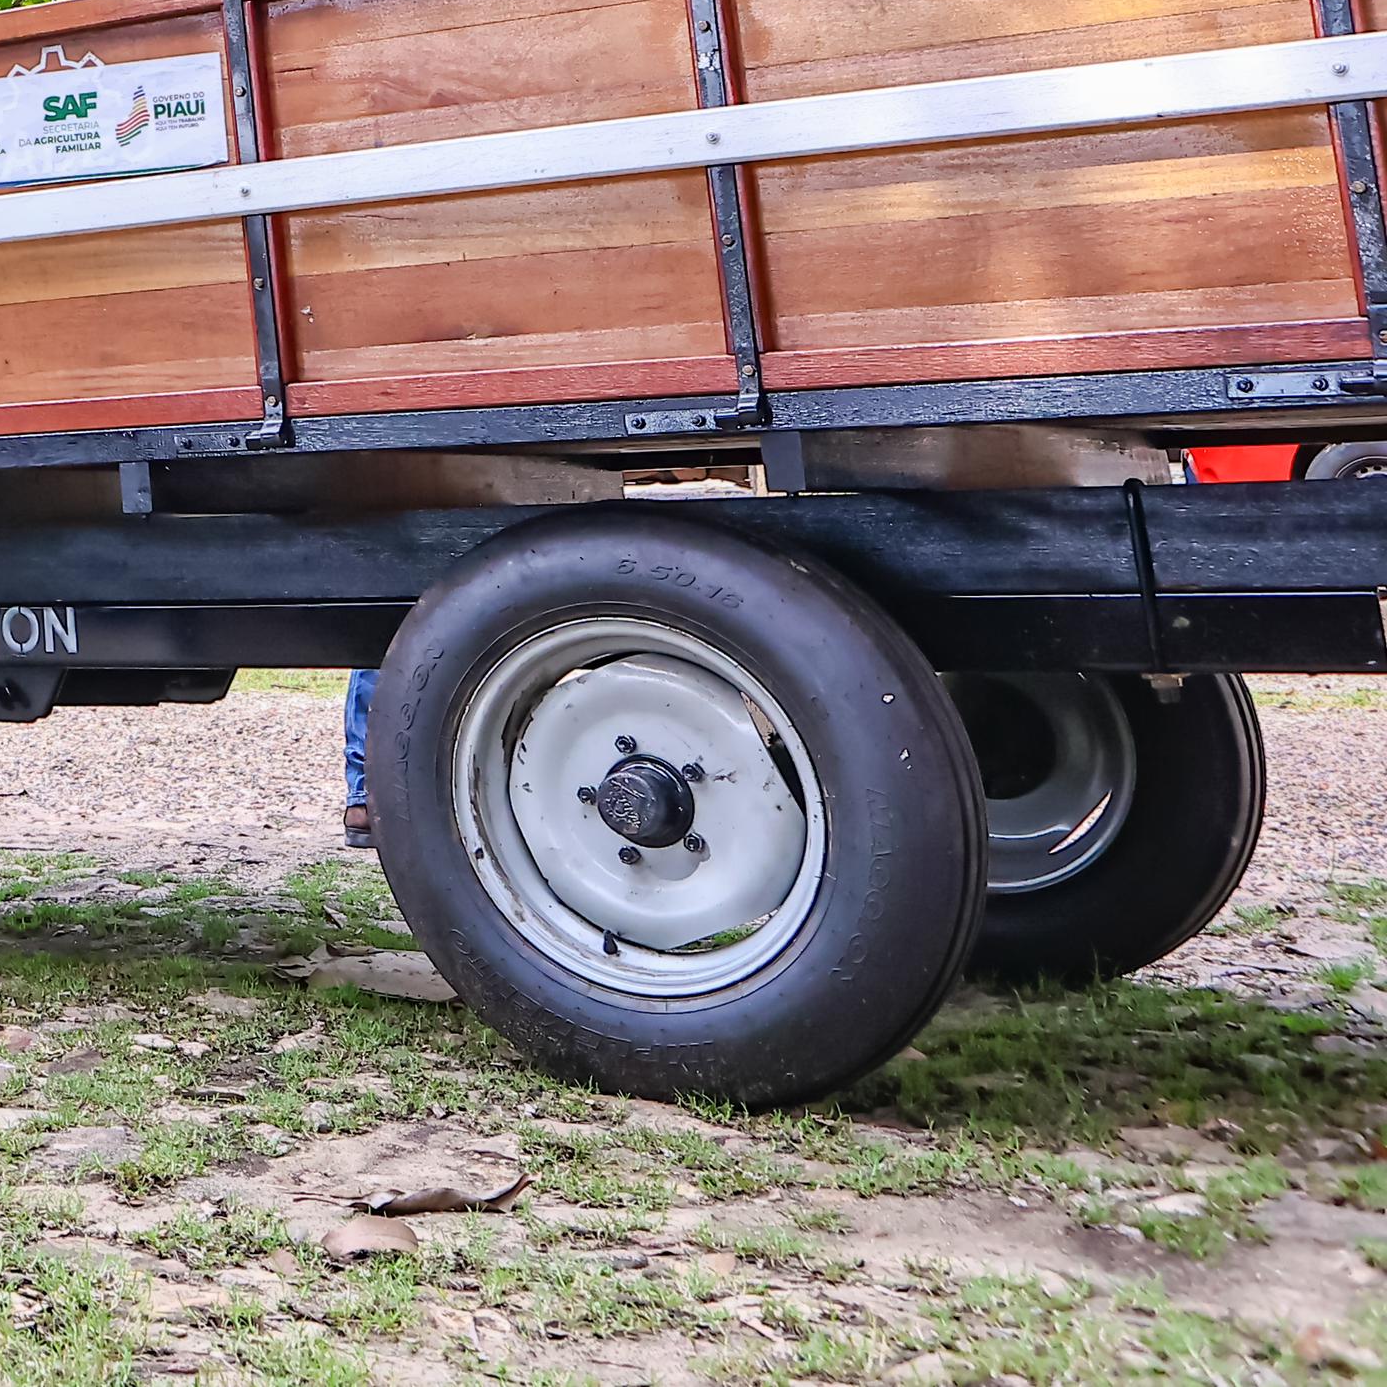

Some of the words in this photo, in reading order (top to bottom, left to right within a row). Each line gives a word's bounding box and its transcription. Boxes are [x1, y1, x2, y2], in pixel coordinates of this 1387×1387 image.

[152, 93, 191, 103] GOVERNO
[193, 91, 205, 99] DO
[43, 91, 98, 122] SAF
[153, 99, 205, 120] PIAUÍ
[42, 121, 100, 134] SECRETARIA
[18, 139, 32, 147] DA
[33, 131, 101, 145] AGRICULTURA
[55, 142, 102, 154] FAMILIAR
